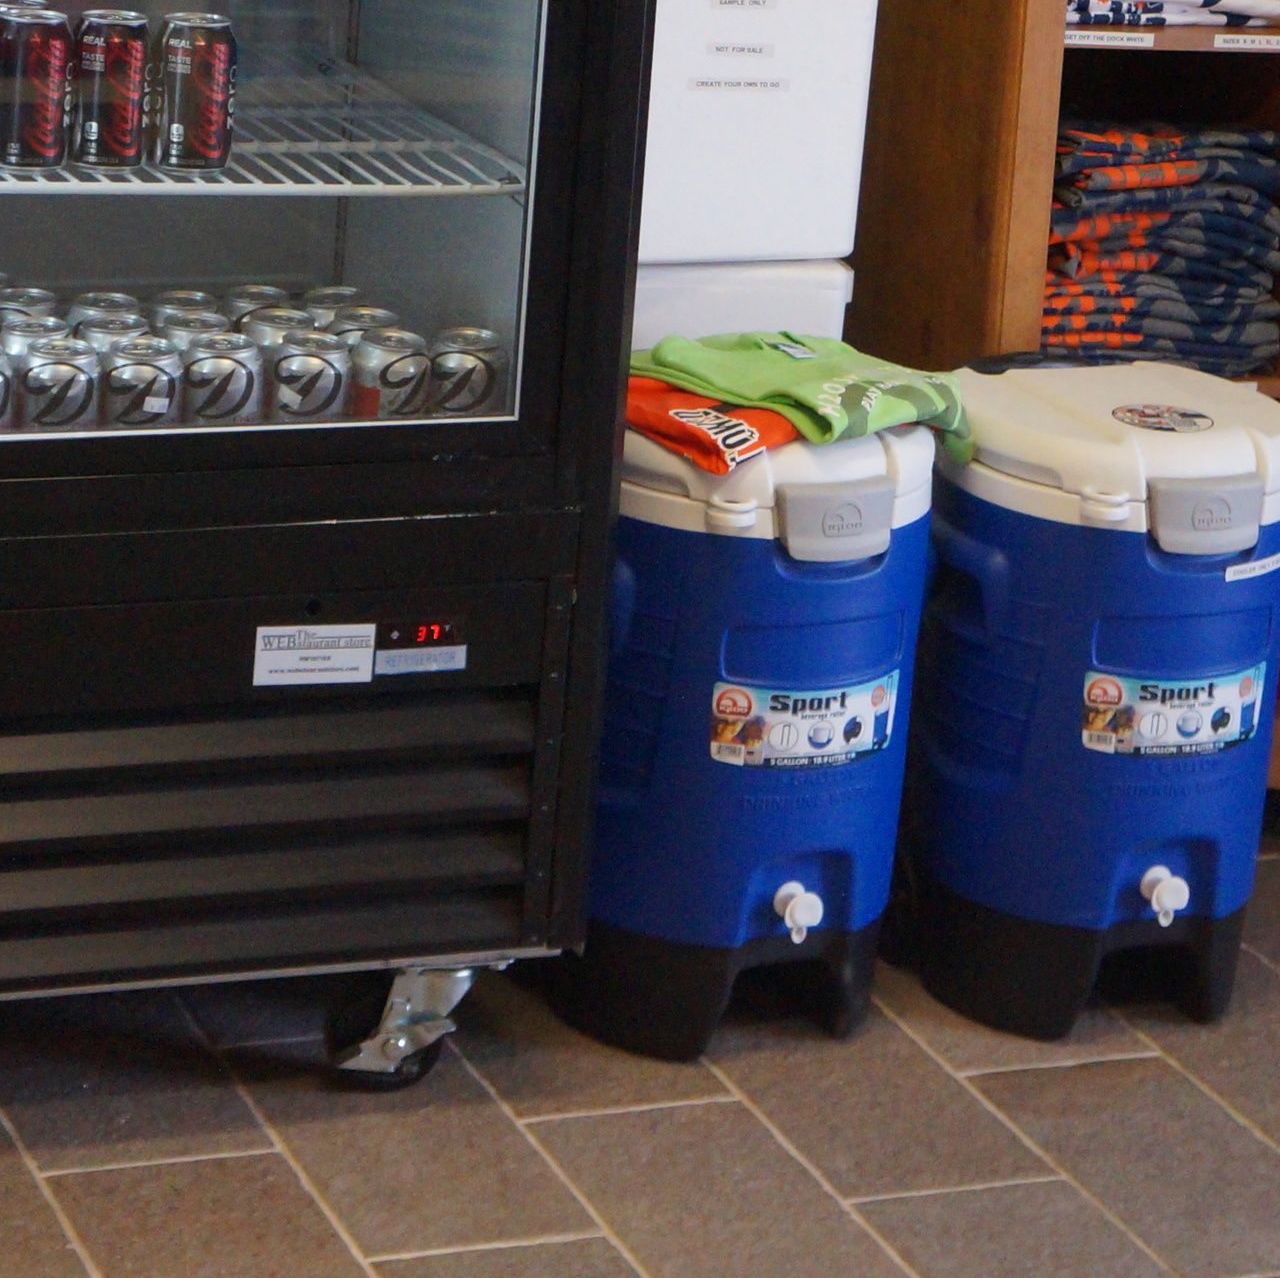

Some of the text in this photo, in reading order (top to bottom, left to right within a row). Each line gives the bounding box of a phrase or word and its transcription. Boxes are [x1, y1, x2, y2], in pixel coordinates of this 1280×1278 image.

[719, 0, 767, 7] SAMPLE ONLY
[82, 35, 107, 46] REAL
[168, 38, 192, 49] REAL
[1106, 35, 1124, 43] DOCK
[81, 51, 105, 62] TASTE
[167, 54, 192, 65] TASTE
[296, 629, 318, 640] The
[415, 624, 440, 643] 37
[1139, 682, 1216, 706] Sport
[769, 691, 848, 716] Sport
[1145, 746, 1177, 755] GALLON
[776, 757, 809, 766] GALLON
